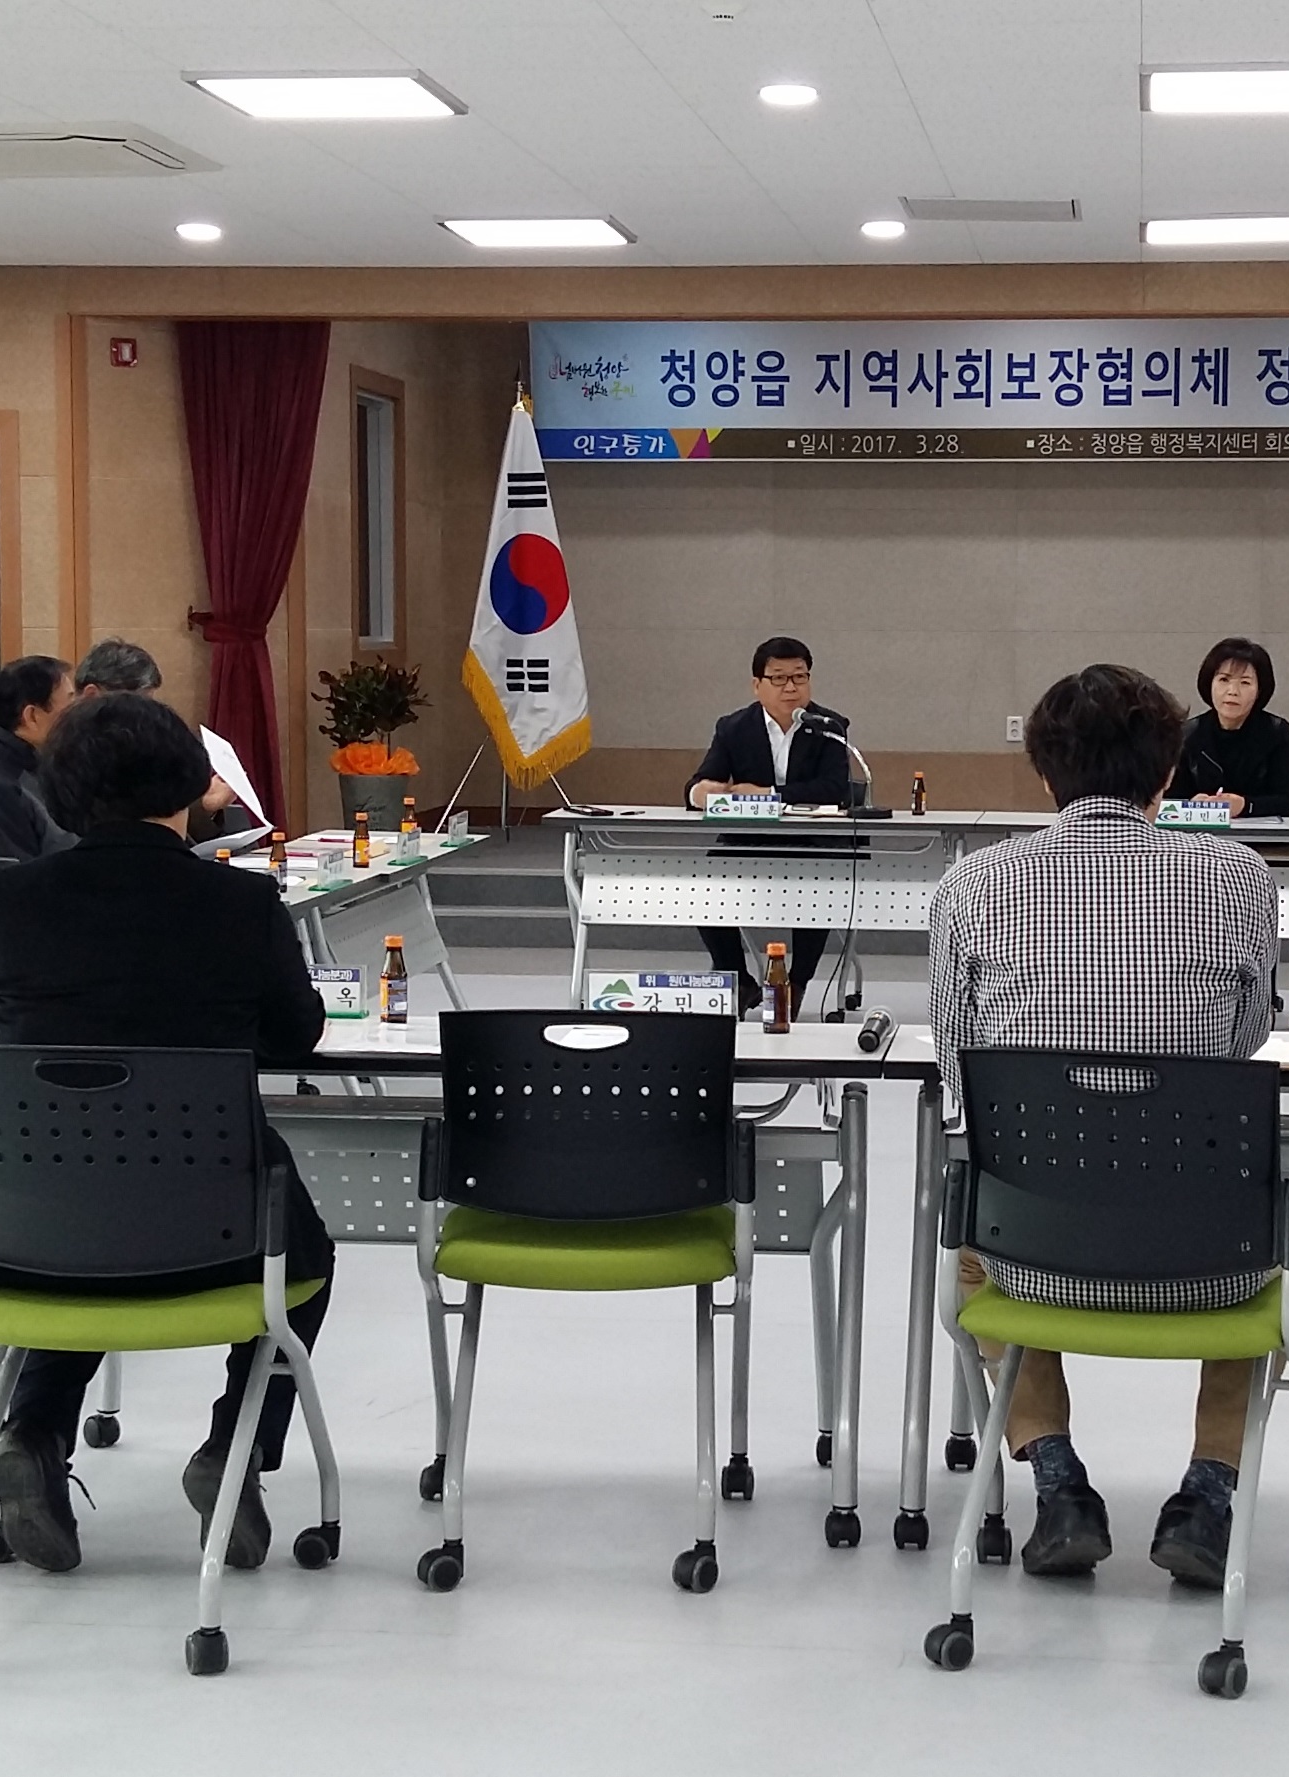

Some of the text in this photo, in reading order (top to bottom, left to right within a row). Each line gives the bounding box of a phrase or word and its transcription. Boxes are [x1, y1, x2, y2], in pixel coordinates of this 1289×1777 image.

[660, 348, 791, 408] 청양읍
[814, 347, 1230, 408] 지역사회보장협의체
[851, 434, 902, 454] 2017.
[1091, 432, 1144, 454] 청양읍
[1150, 432, 1258, 454] 행정복지센터
